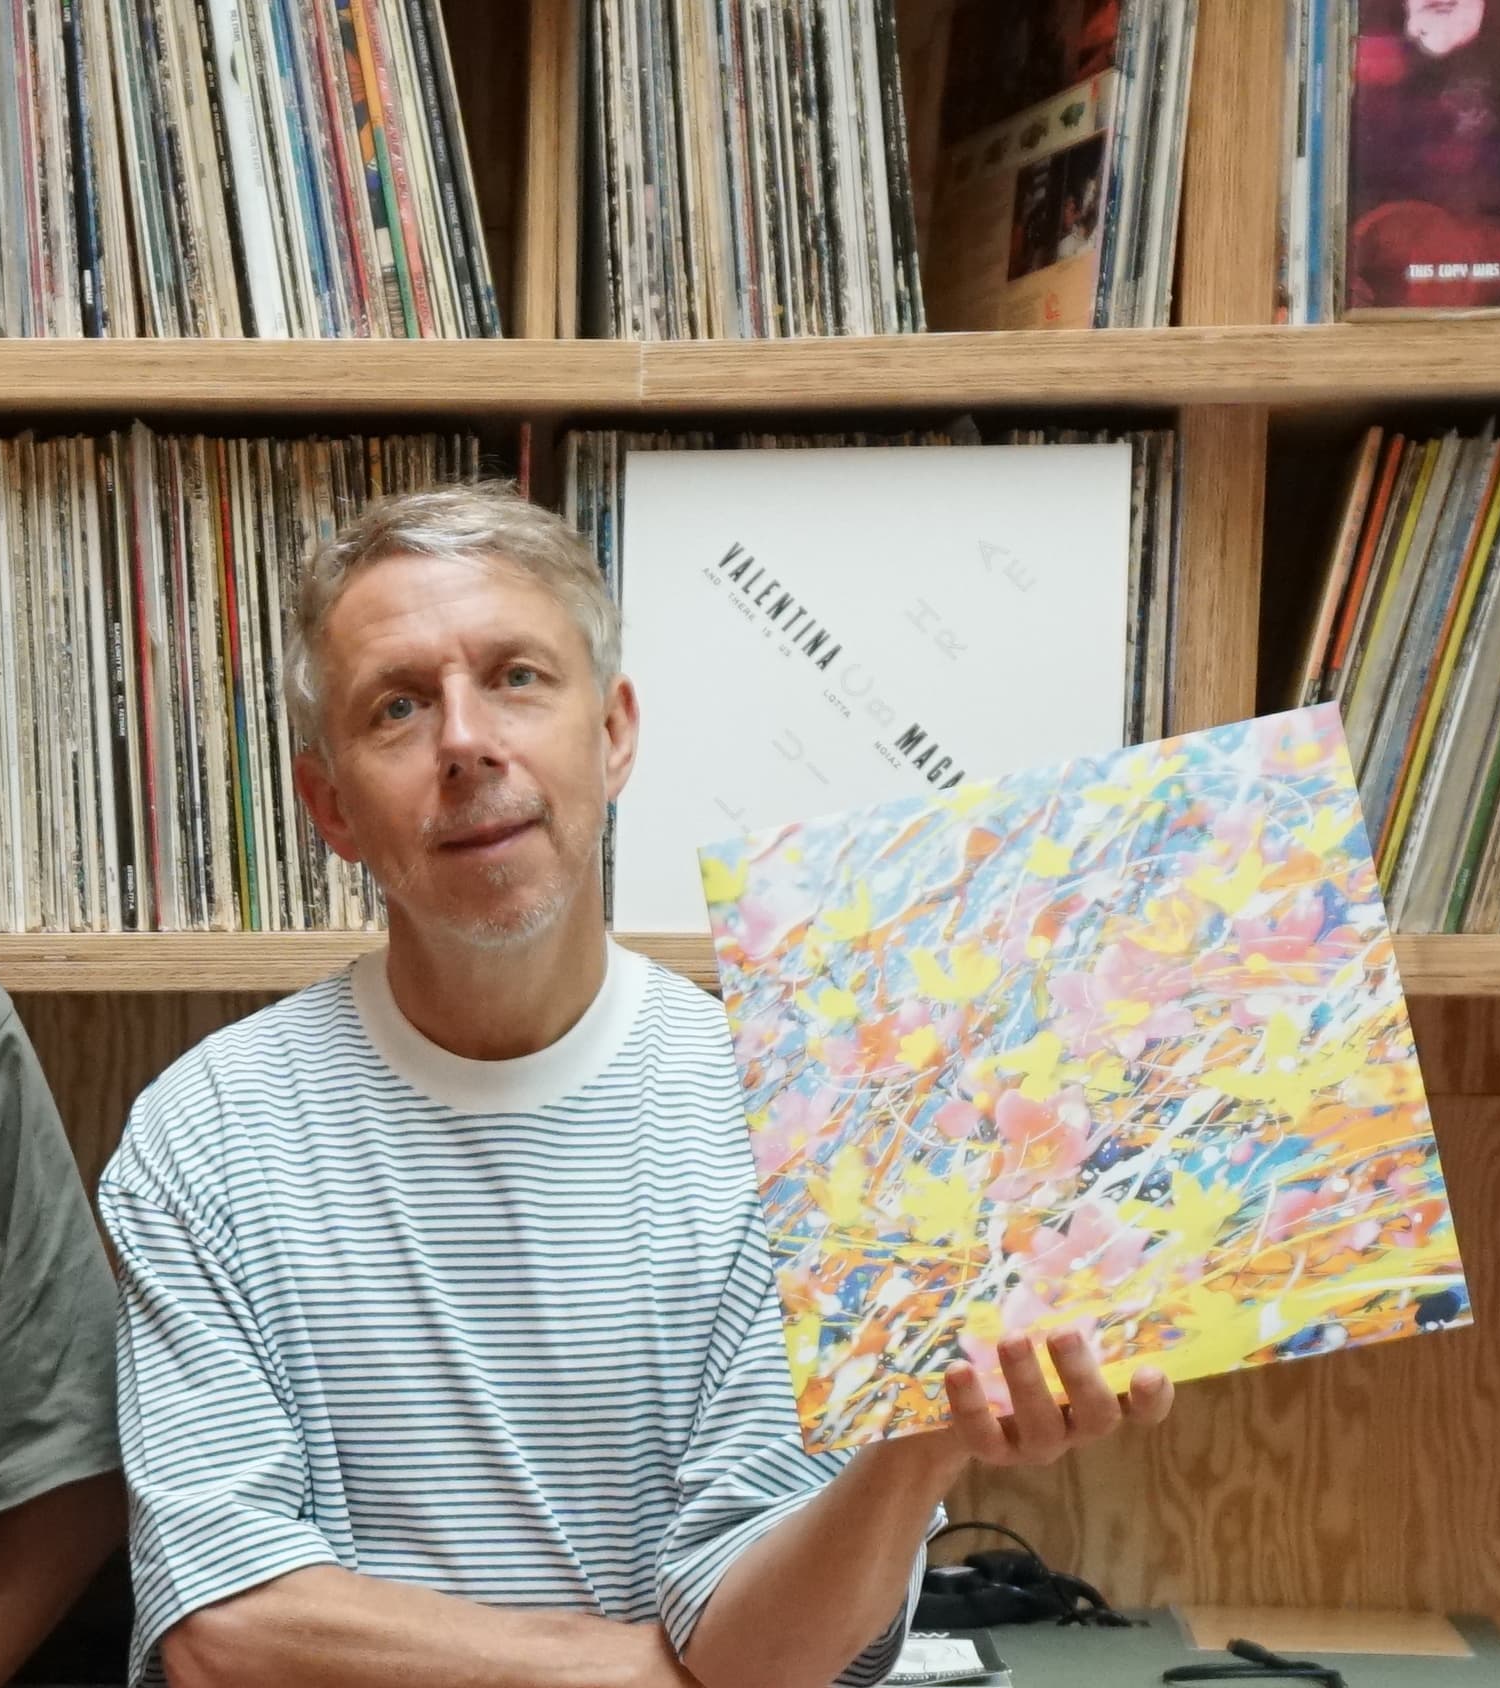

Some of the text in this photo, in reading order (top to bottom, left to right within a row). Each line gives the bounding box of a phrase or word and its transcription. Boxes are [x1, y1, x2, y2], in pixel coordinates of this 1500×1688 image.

[1409, 264, 1433, 277] THIS
[1438, 264, 1468, 277] COPY
[1472, 263, 1499, 277] WAS
[702, 567, 721, 586] AND
[728, 591, 755, 622] THERE
[823, 689, 851, 718] LOTTA
[718, 541, 842, 671] VALENTINA
